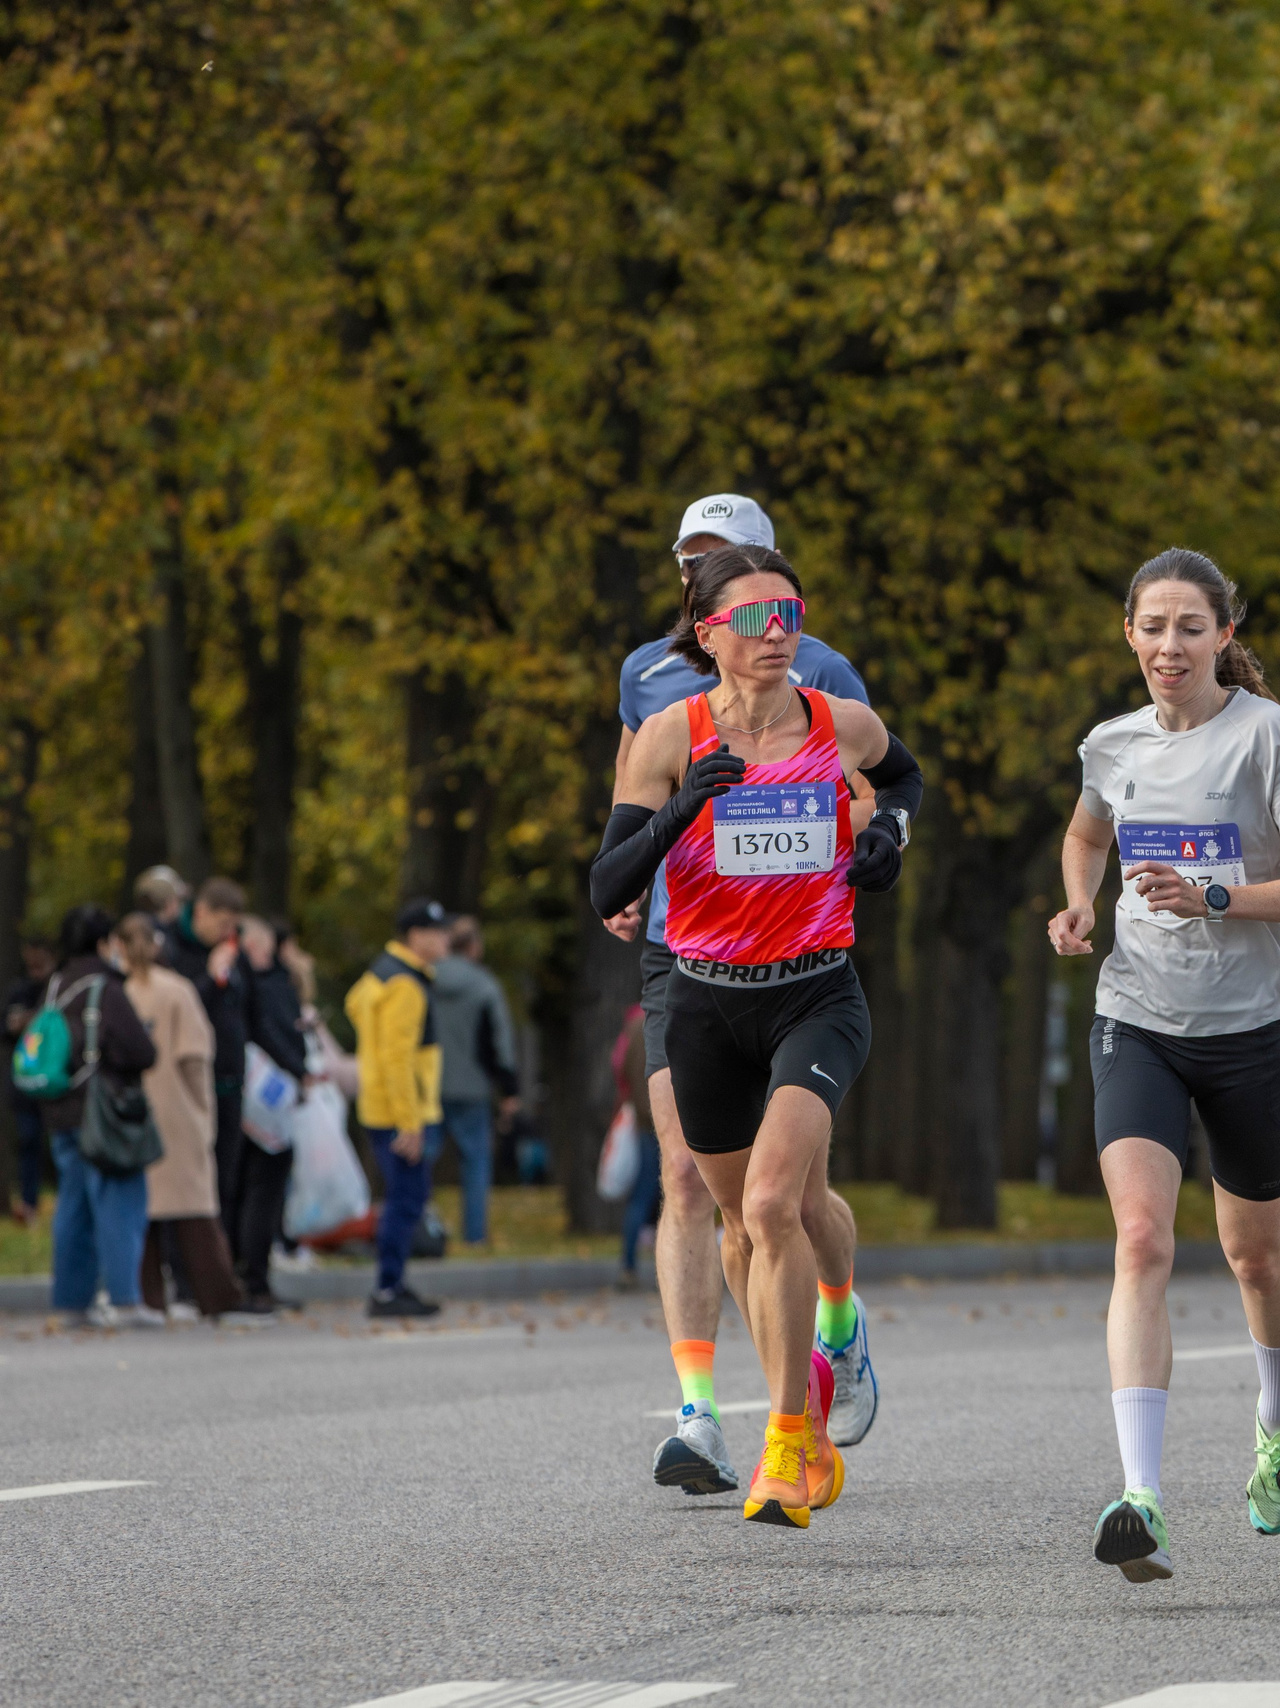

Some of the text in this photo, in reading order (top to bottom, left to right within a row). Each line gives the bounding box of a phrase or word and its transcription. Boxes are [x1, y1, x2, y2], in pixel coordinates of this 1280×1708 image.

[727, 808, 742, 816] МОЯ
[742, 807, 777, 815] СТОЛИЦА
[732, 832, 809, 855] 13703
[708, 960, 773, 983] PRO
